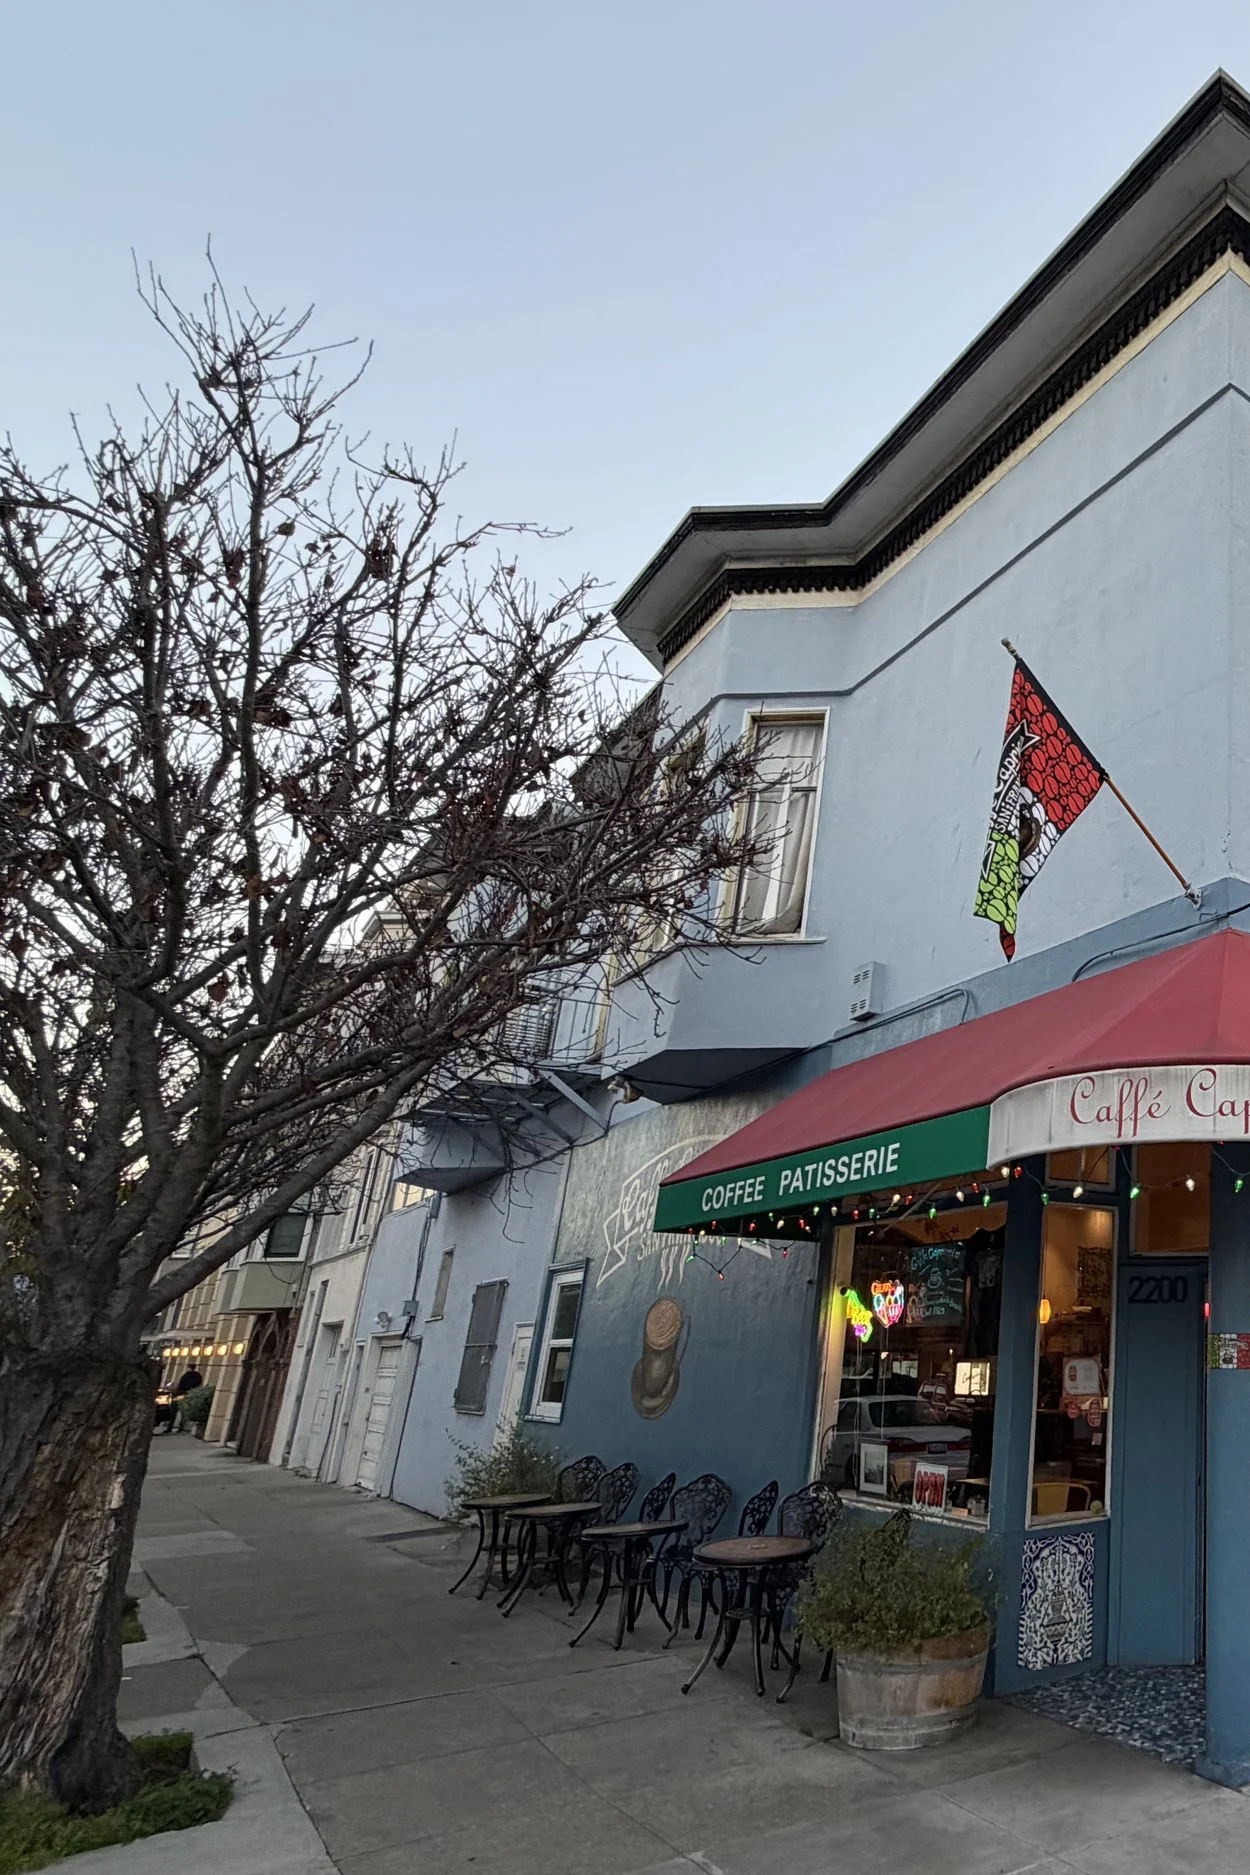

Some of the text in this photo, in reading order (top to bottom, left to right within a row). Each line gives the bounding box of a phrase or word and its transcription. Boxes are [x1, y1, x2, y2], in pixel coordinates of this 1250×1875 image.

[995, 809, 1014, 833] SAN
[1070, 1076, 1171, 1138] Caffé
[702, 1142, 901, 1212] COFFEE PATISSERIE
[1128, 1275, 1187, 1304] 2200
[915, 1470, 945, 1508] OPEN
